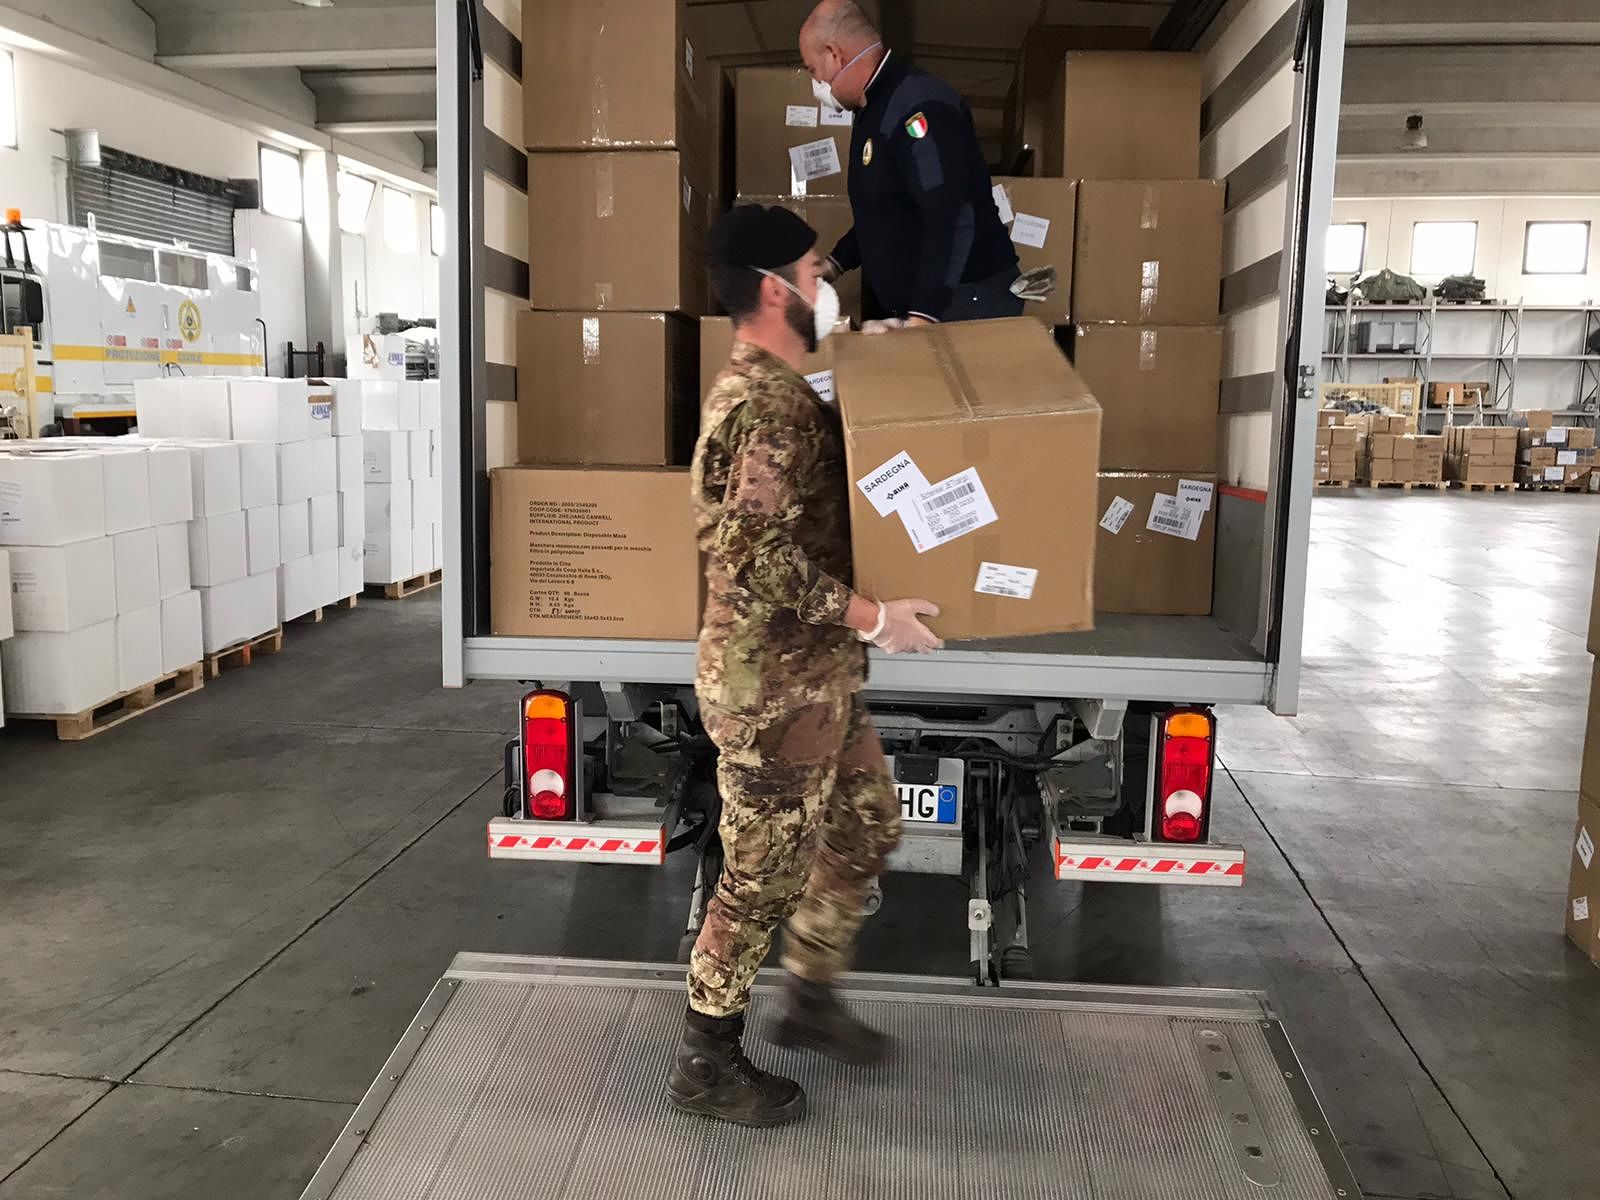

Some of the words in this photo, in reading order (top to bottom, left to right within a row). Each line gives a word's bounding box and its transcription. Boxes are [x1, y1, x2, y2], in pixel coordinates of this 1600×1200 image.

[864, 459, 911, 493] SARDEGNA
[1180, 484, 1212, 492] SARDEGNA
[898, 787, 934, 818] HG
